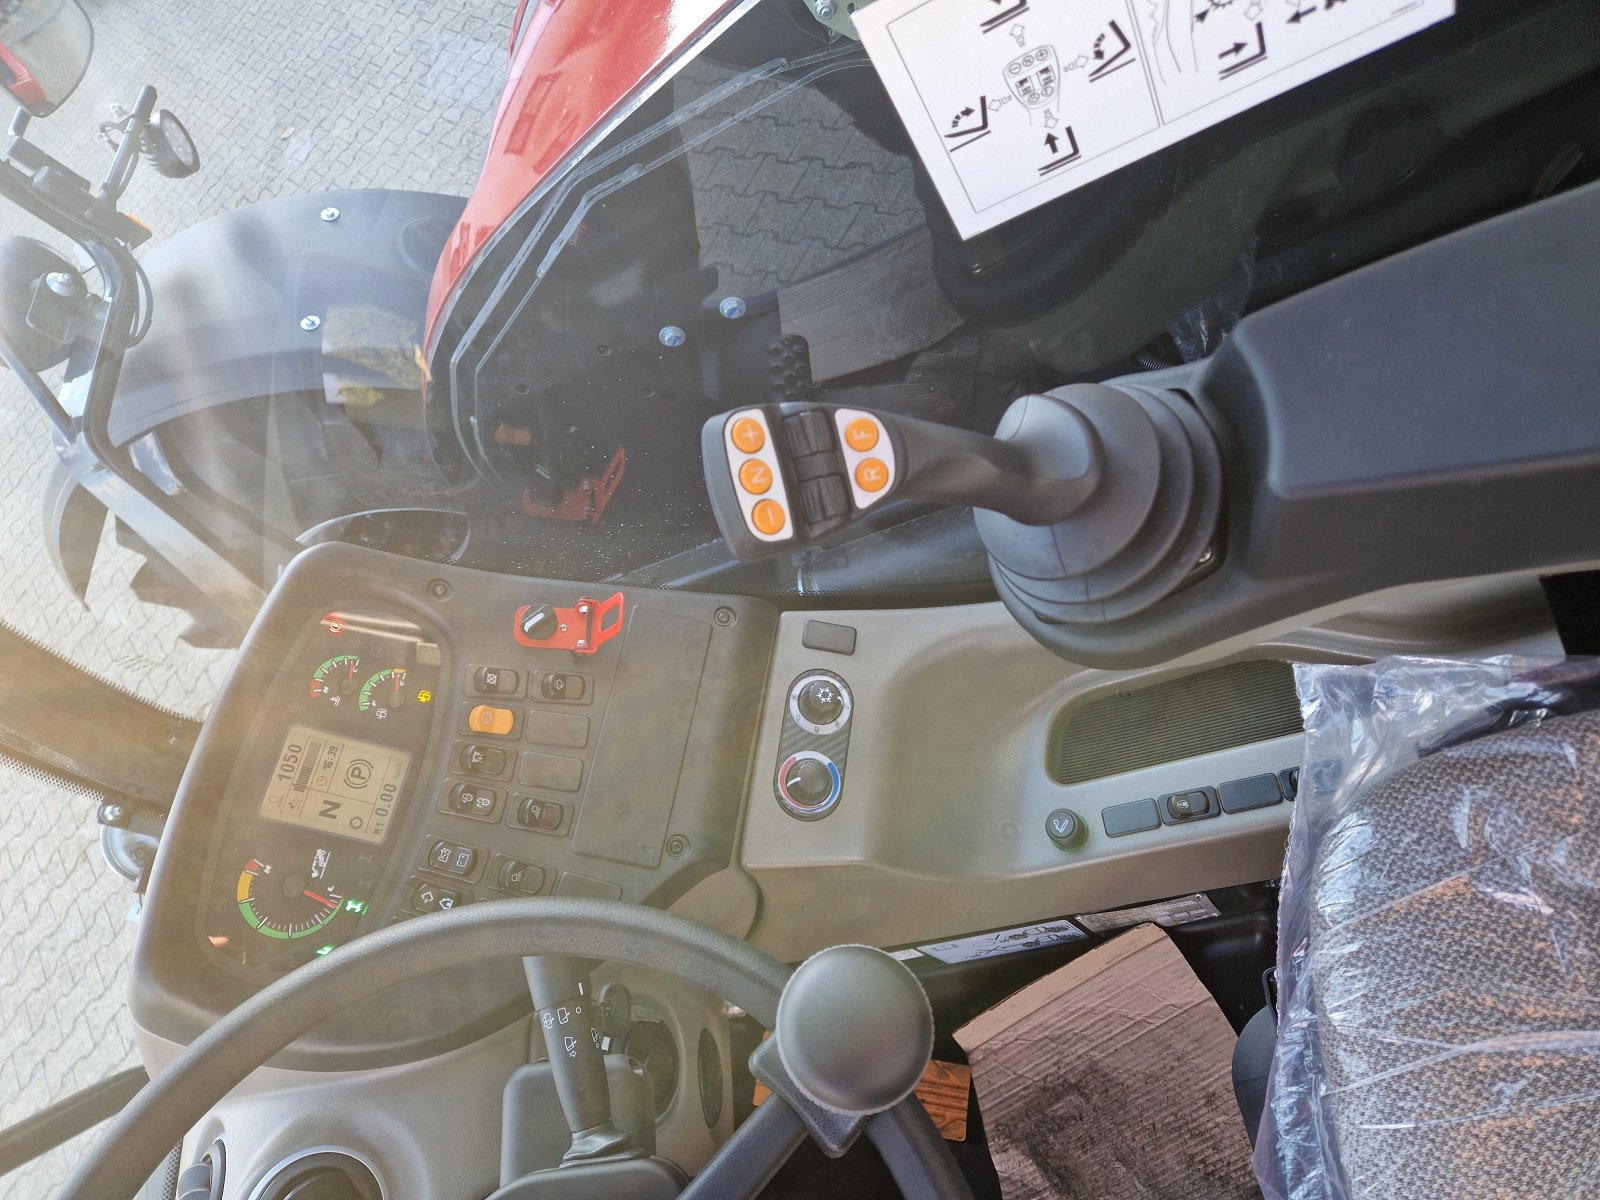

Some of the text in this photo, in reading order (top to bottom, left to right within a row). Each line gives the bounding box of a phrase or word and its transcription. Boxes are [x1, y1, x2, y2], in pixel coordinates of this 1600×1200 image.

[852, 428, 872, 442] F
[751, 467, 768, 484] N
[863, 467, 882, 483] R
[277, 744, 302, 782] 1050
[322, 745, 339, 771] 16:39
[318, 799, 342, 820] N
[375, 783, 397, 818] 0.00
